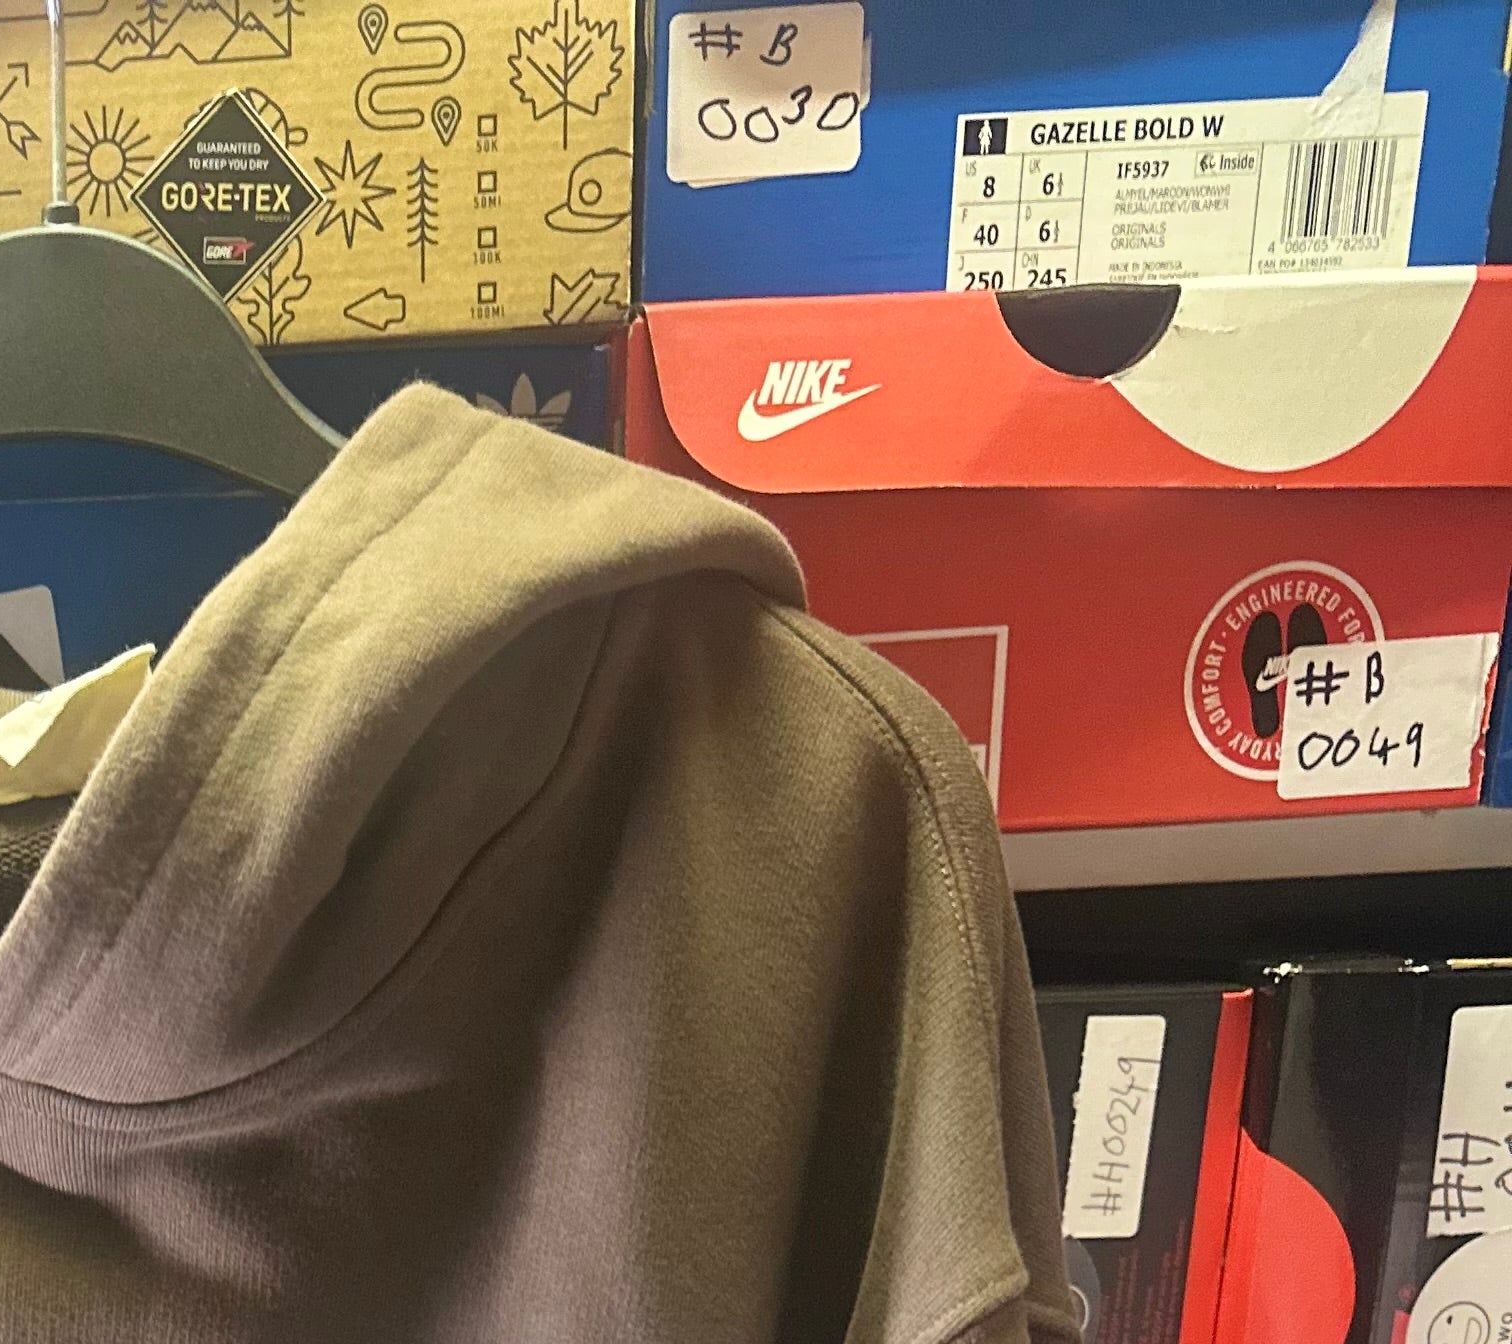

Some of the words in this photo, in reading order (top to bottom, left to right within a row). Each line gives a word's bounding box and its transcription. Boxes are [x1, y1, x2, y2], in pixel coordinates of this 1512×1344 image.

[763, 24, 798, 65] B
[697, 86, 859, 143] 0030
[1031, 119, 1128, 146] GAZELLE
[1135, 116, 1194, 141] BOLD
[1202, 115, 1225, 138] W
[196, 142, 261, 155] GUARANTEED
[476, 140, 498, 152] 50K
[189, 158, 201, 170] TO
[202, 158, 227, 171] KEEP
[228, 158, 247, 171] YOU
[249, 158, 269, 171] DRY
[1117, 160, 1171, 180] IF5937
[1219, 153, 1256, 170] Inside
[983, 175, 996, 199] 8
[973, 223, 999, 247] 40
[1111, 223, 1167, 238] ORIGINALS
[1110, 237, 1166, 251] ORIGINALS
[473, 252, 501, 264] 100K
[964, 270, 1004, 292] 250
[1027, 268, 1067, 289] 245
[756, 359, 853, 404] NIKE
[1224, 580, 1342, 631] ENGINEERED
[1264, 655, 1289, 677] NIK
[1365, 651, 1385, 704] B
[1200, 640, 1233, 737] COMFORT
[1297, 722, 1424, 771] 0049
